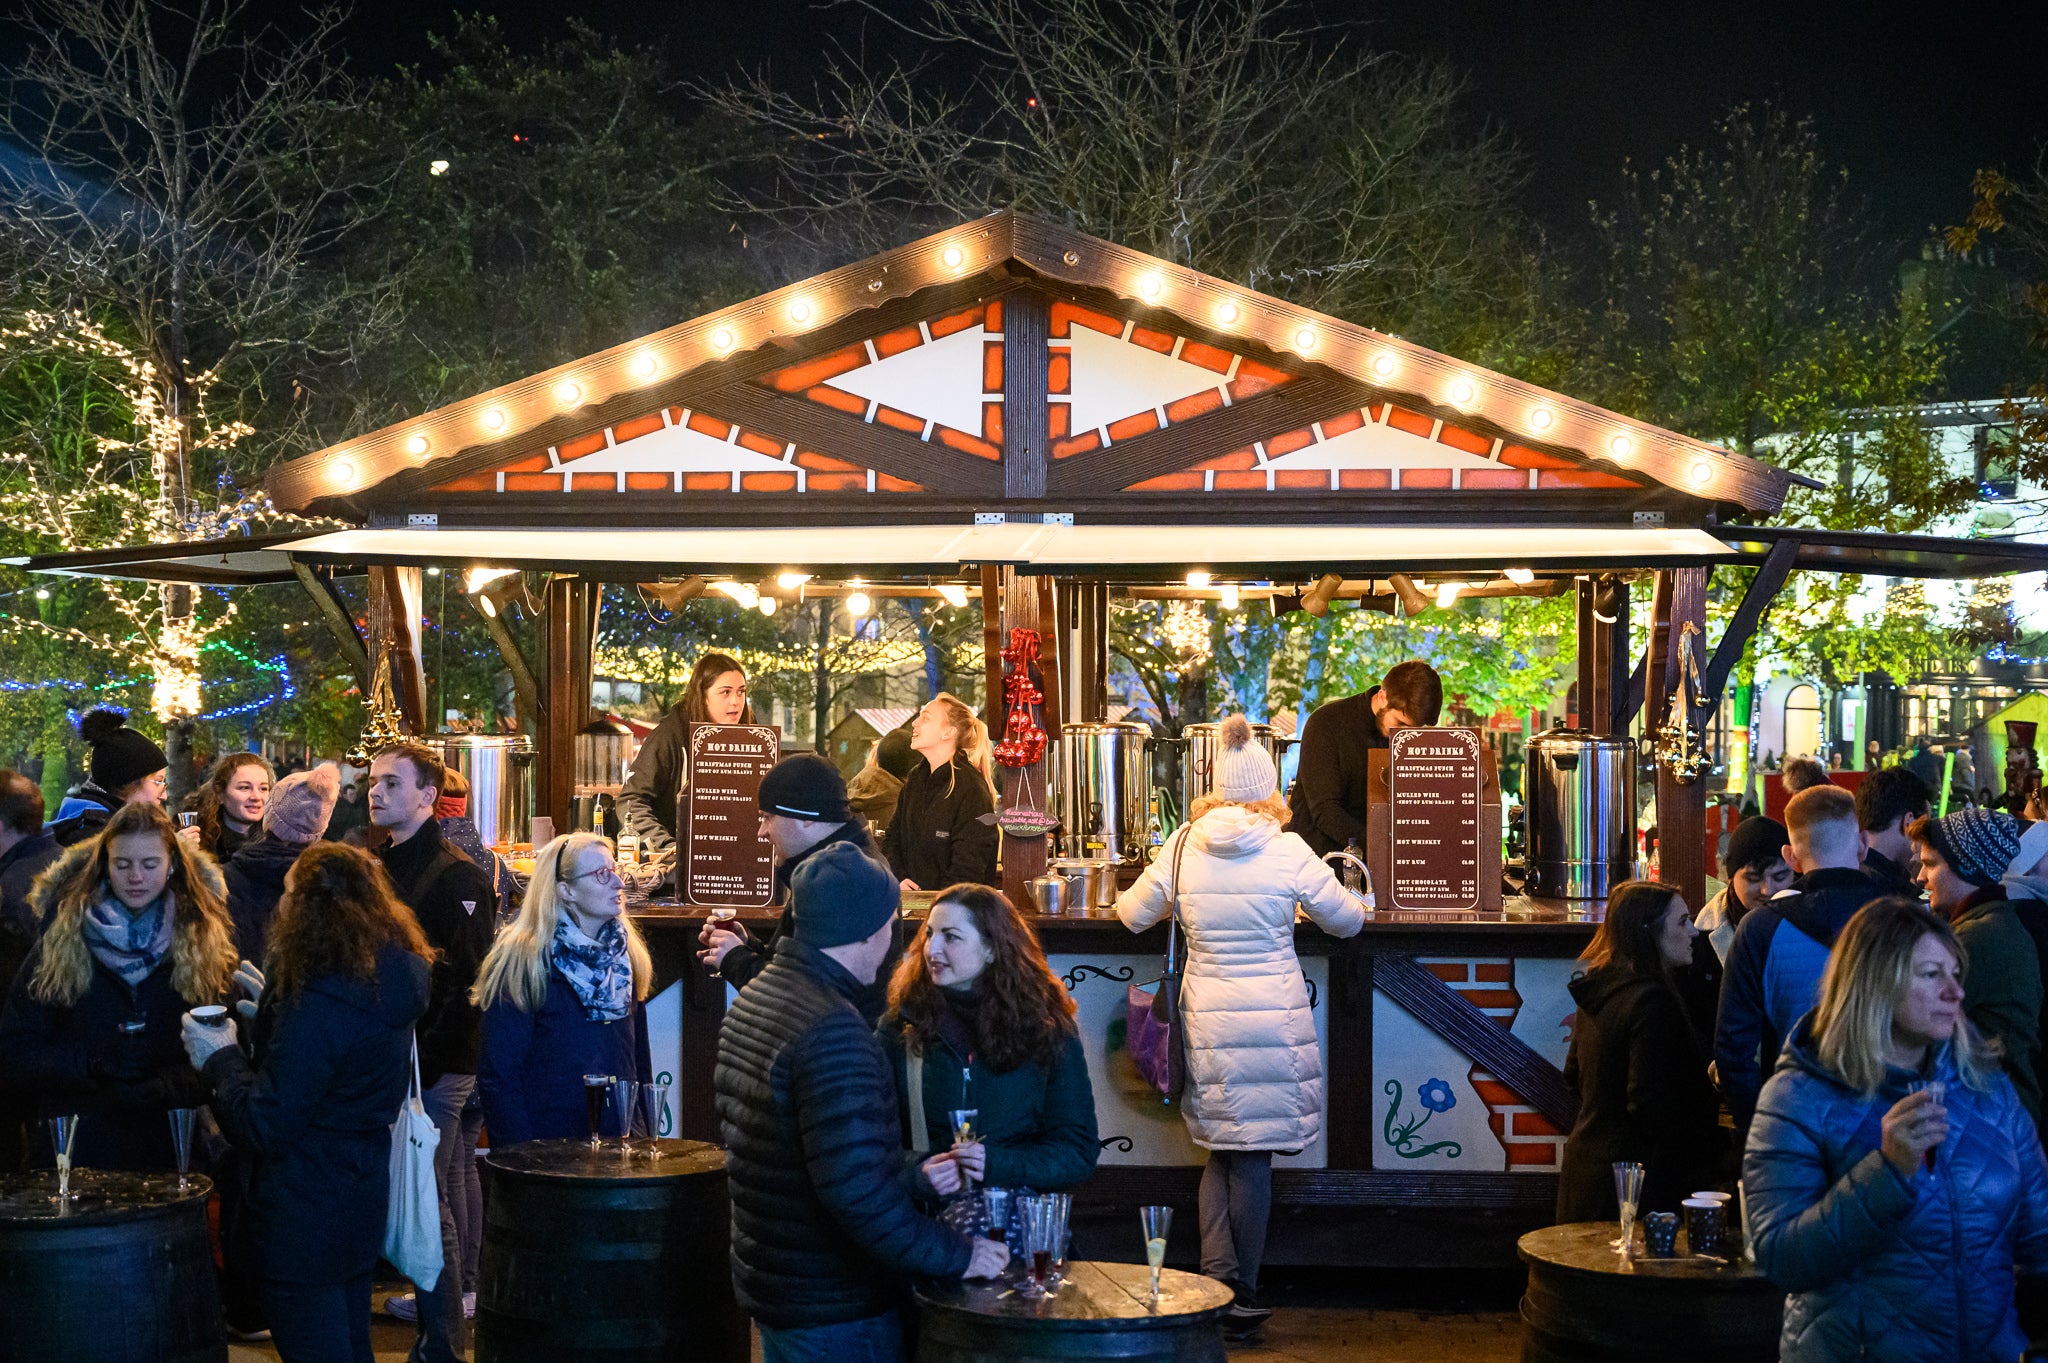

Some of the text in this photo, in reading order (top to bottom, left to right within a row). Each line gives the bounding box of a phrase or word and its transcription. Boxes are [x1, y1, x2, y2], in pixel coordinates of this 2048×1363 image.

[707, 742, 762, 753] HOT DRINKS
[1407, 747, 1464, 755] HOT DRINKS
